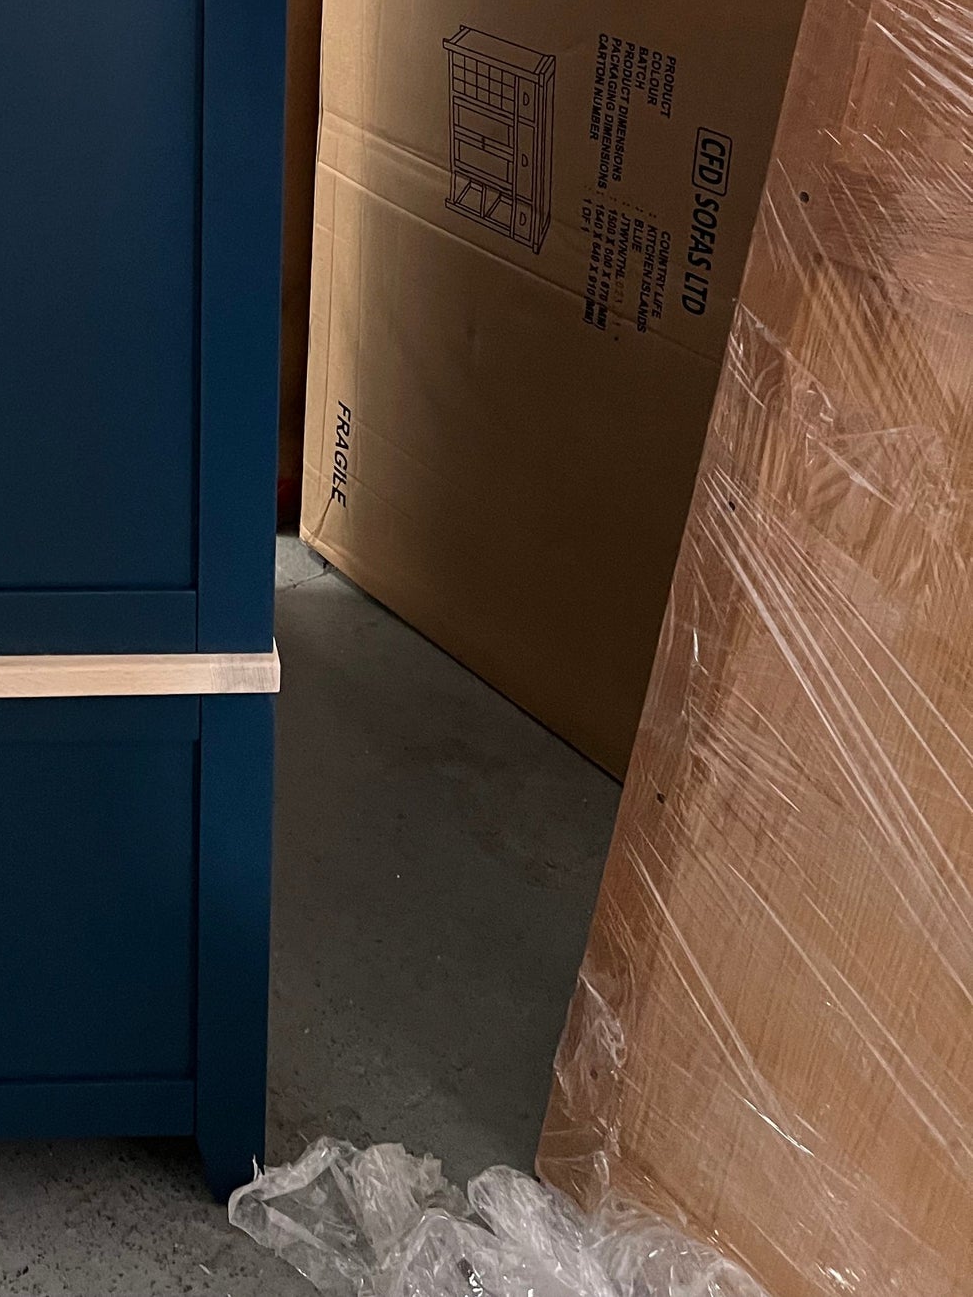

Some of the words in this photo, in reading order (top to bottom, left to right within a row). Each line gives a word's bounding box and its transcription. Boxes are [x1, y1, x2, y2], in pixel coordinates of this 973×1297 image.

[594, 33, 608, 86] CARTON
[606, 36, 622, 111] PACKAGING
[621, 42, 635, 104] PRODUCT
[635, 46, 648, 90] BATCH
[647, 52, 662, 106] COLOUR
[660, 55, 676, 119] PRODUCT
[590, 87, 604, 140] NUMBER
[598, 113, 614, 189] DIMENSIONS
[612, 105, 628, 182] DIMENSIONS
[699, 138, 726, 184] CFD
[632, 218, 644, 253] BLUE
[643, 224, 658, 281] KITCHEN
[688, 194, 719, 271] SOFAS
[656, 231, 671, 291] COUNTRY
[637, 280, 652, 334] ISLANDS
[652, 291, 664, 319] LIFE
[682, 271, 709, 316] LTD
[332, 400, 351, 508] FRAGILE
